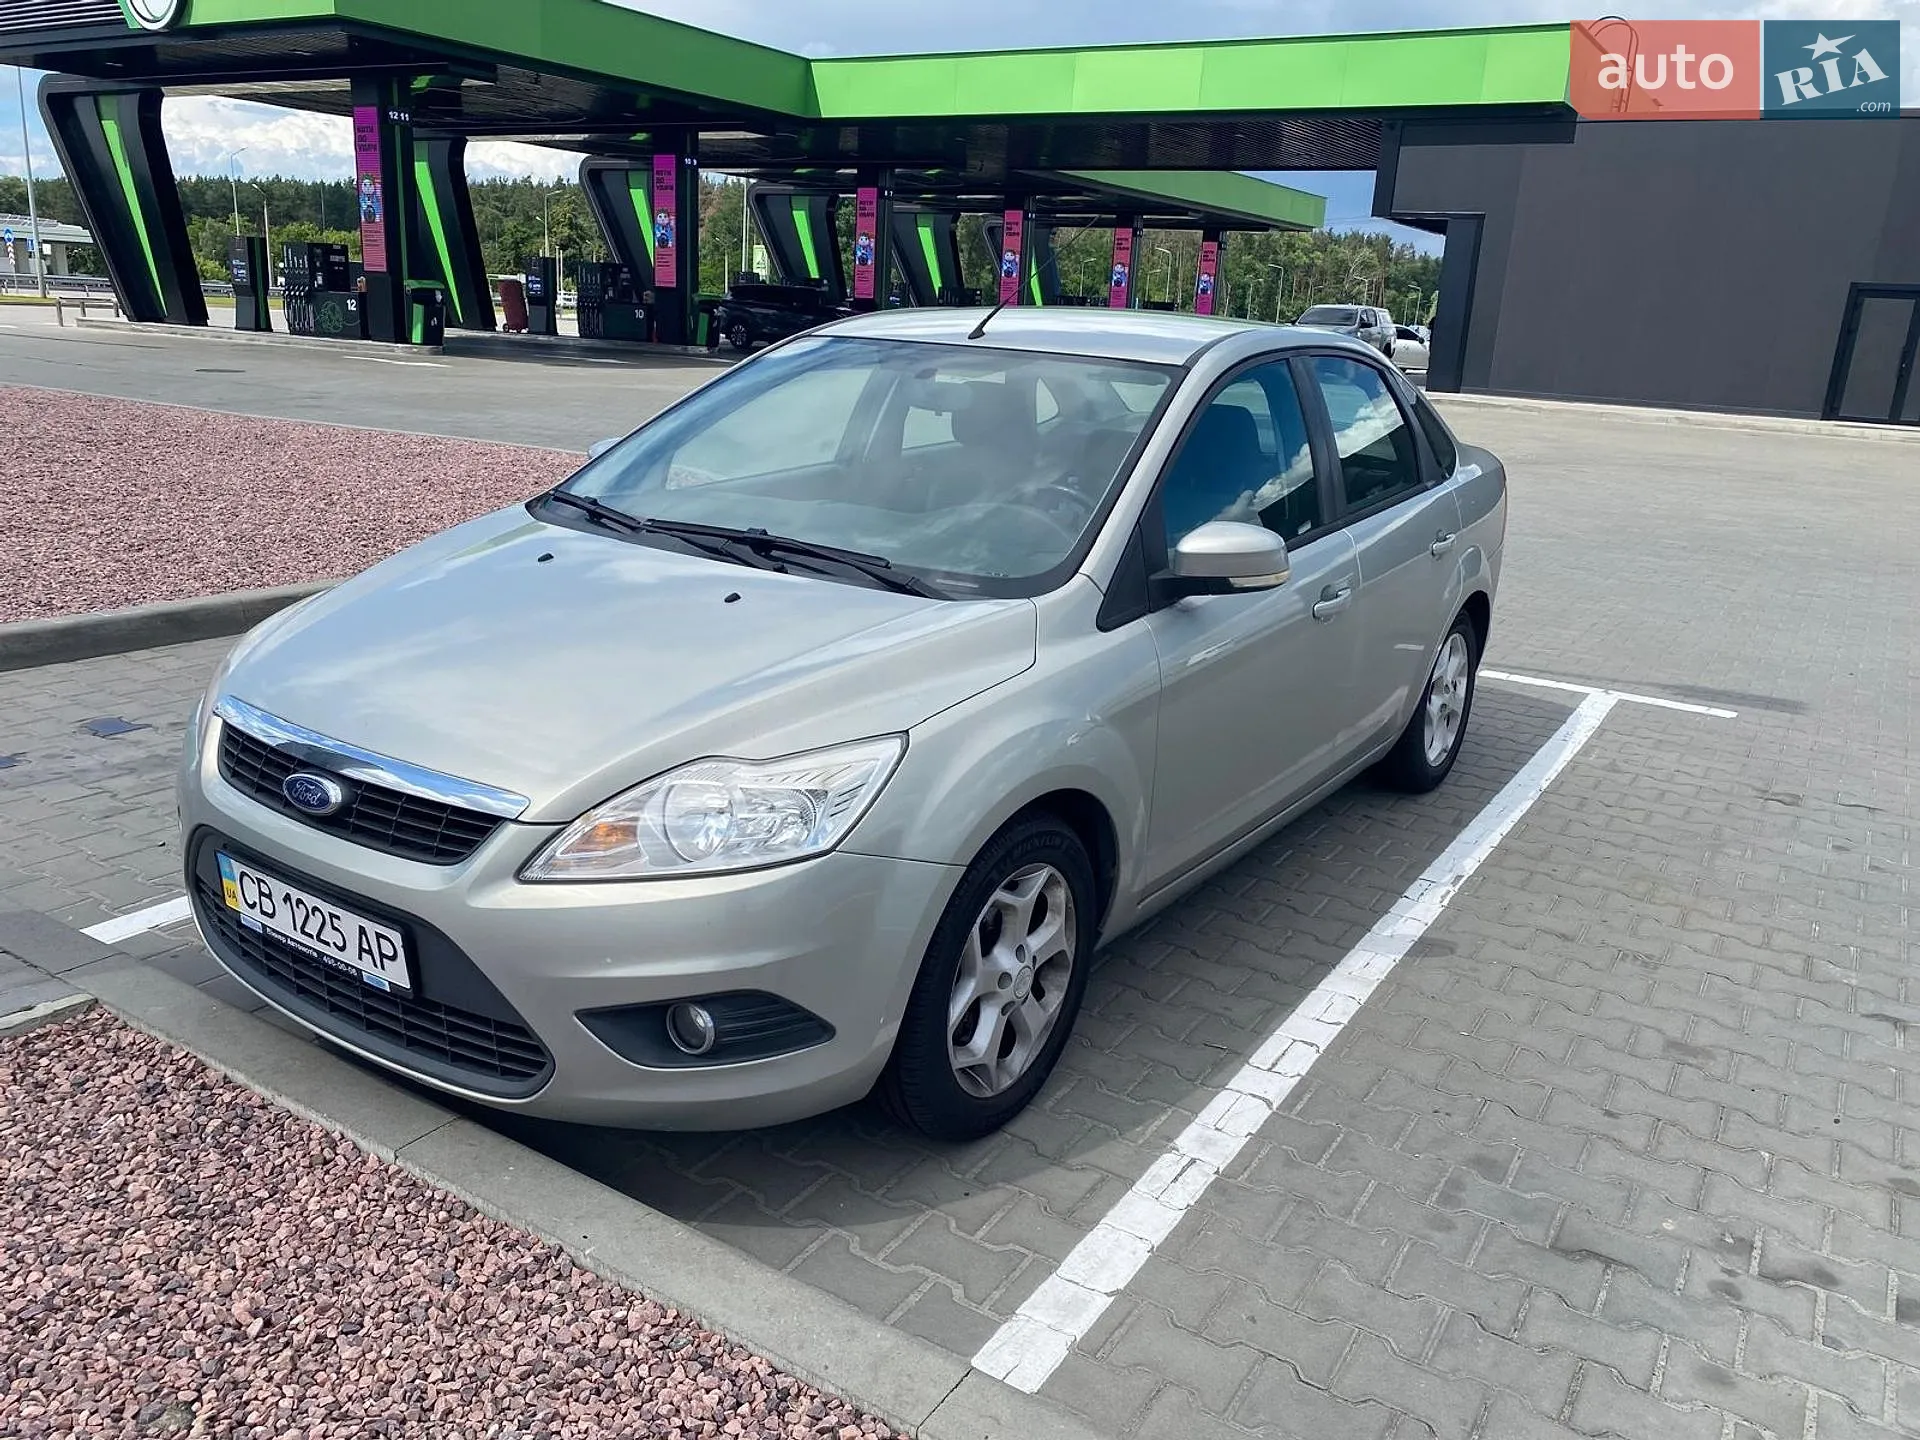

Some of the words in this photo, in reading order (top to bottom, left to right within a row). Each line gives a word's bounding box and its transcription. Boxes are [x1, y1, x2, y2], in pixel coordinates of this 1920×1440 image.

[389, 111, 398, 120] 12
[400, 112, 409, 121] 11
[346, 299, 357, 311] 12
[634, 309, 645, 319] 10
[292, 780, 322, 806] Ford
[226, 887, 238, 903] UA
[238, 870, 277, 919] CB
[282, 892, 347, 952] 1225
[357, 924, 398, 971] AP
